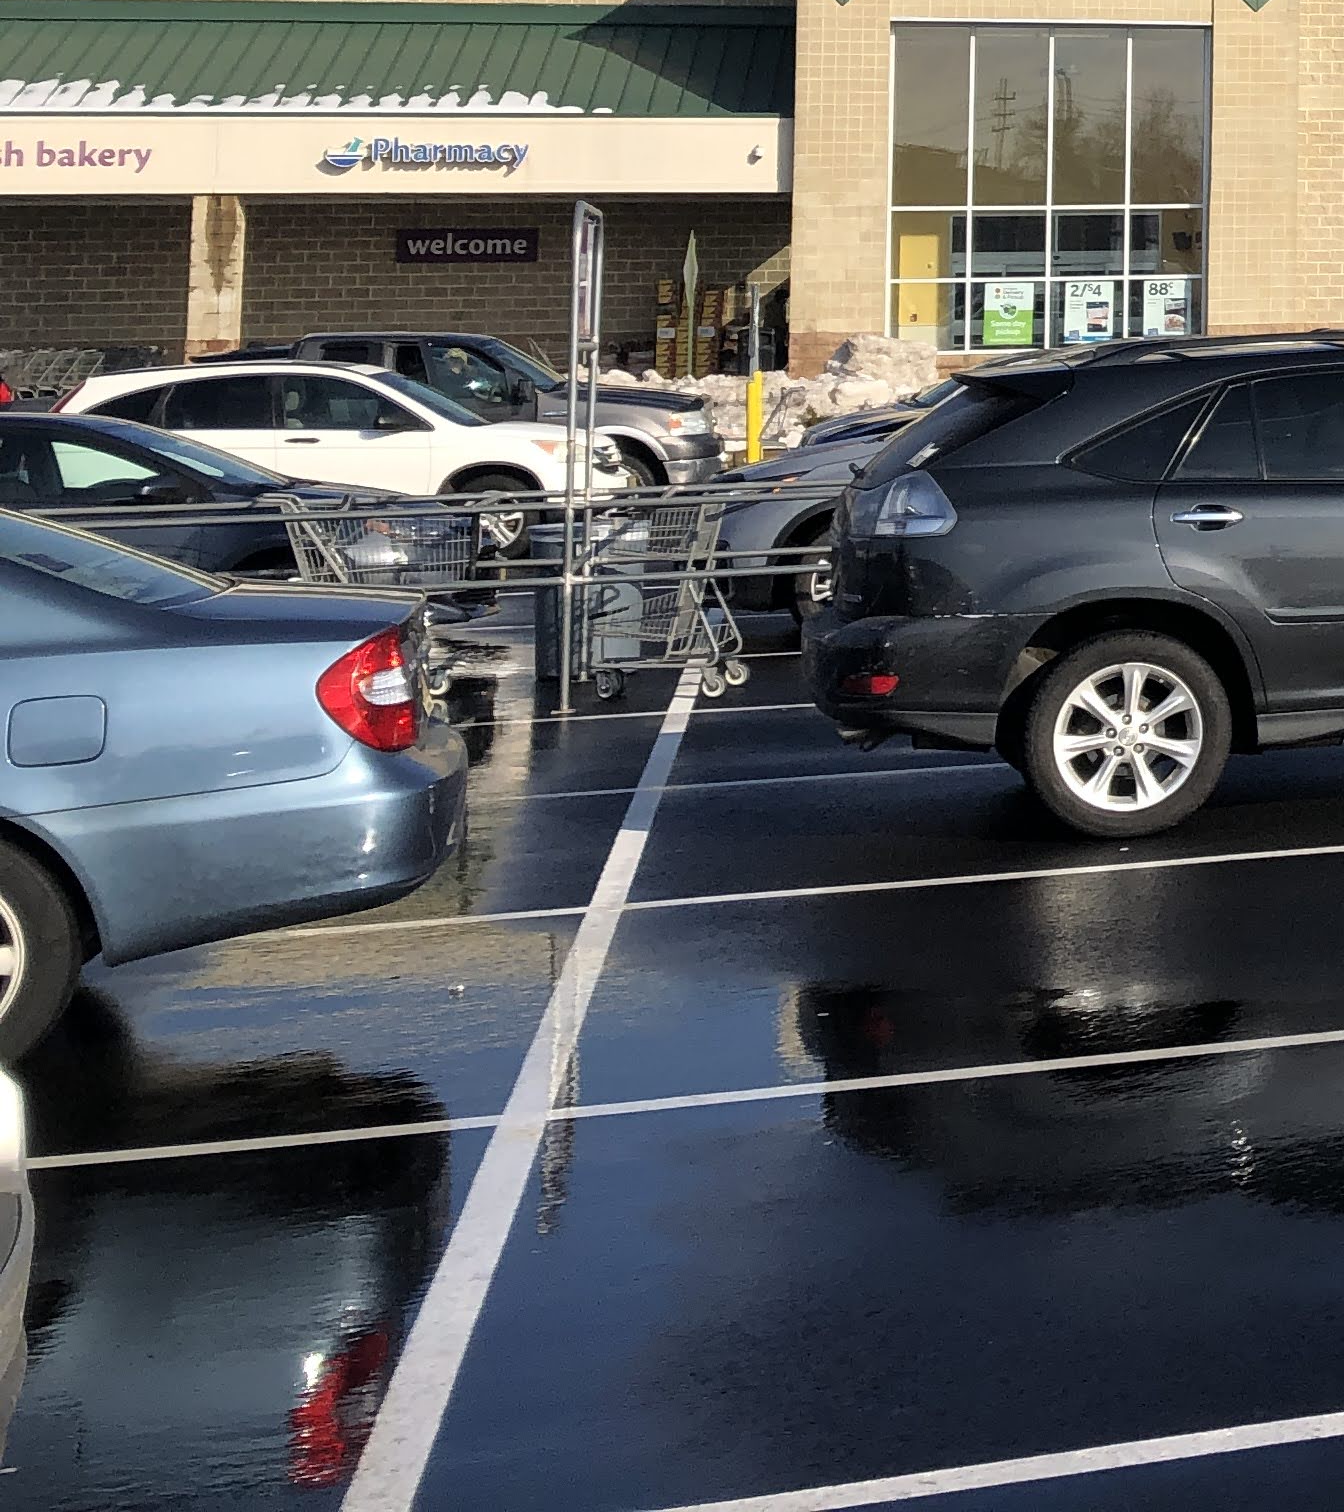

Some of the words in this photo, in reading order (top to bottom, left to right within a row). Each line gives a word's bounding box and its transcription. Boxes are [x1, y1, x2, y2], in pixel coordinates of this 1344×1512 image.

[0, 140, 24, 167] h
[36, 140, 152, 173] bakery
[371, 137, 529, 168] Pharmacy
[406, 232, 527, 255] welcome
